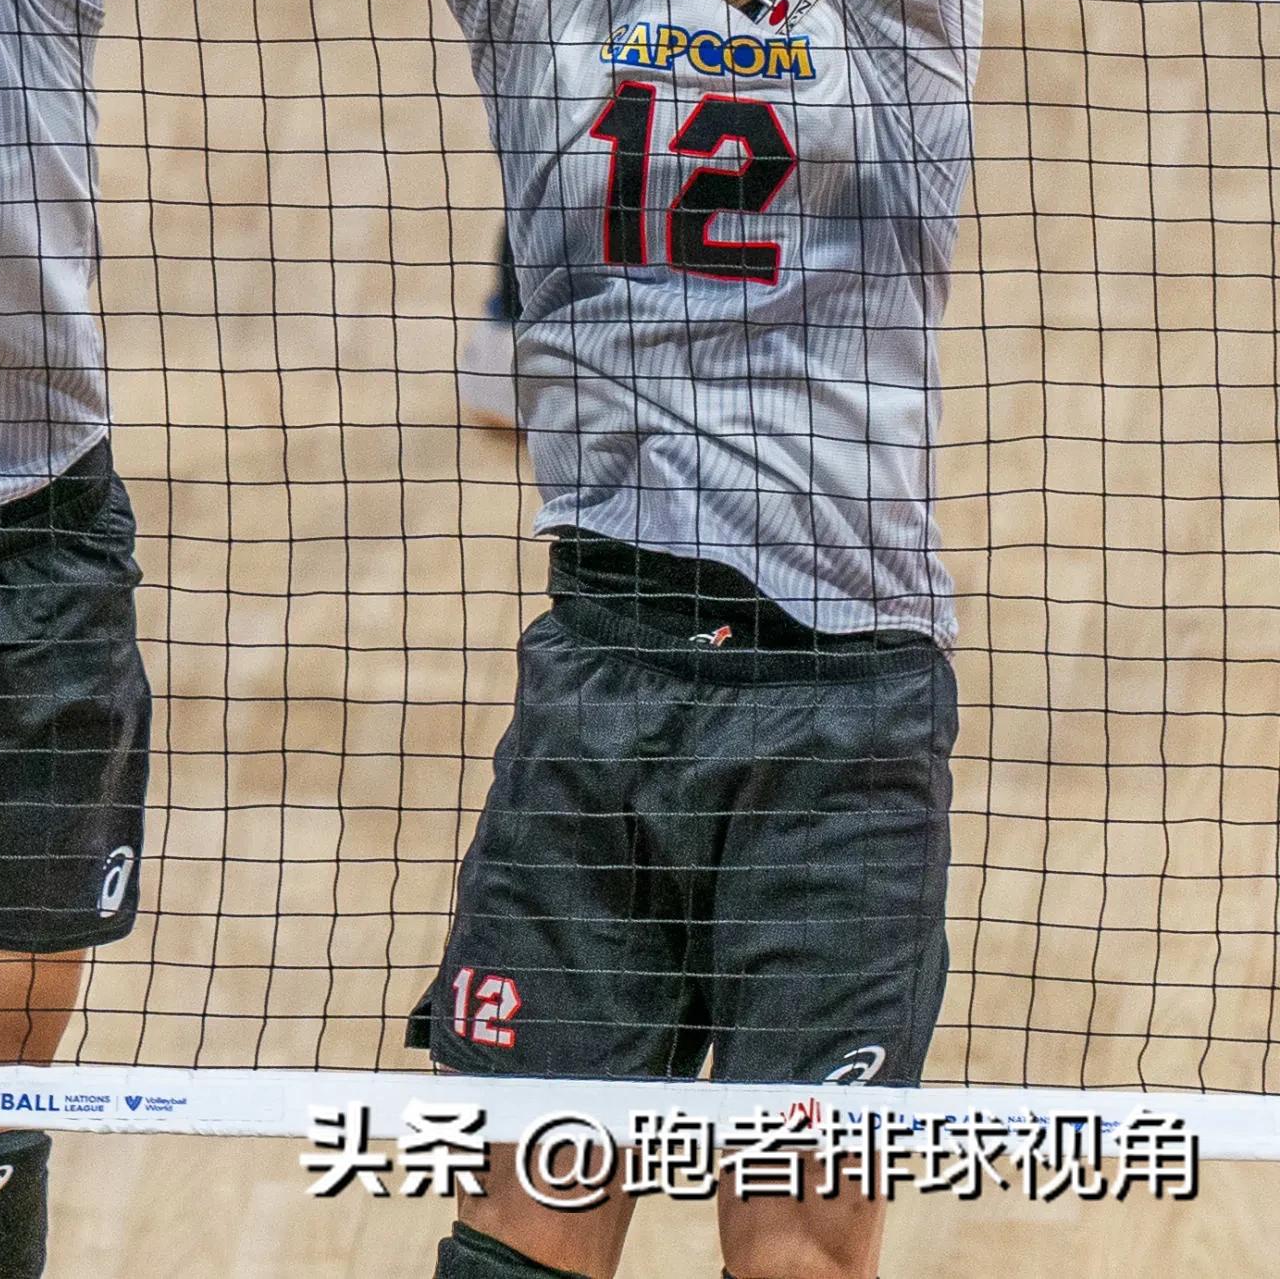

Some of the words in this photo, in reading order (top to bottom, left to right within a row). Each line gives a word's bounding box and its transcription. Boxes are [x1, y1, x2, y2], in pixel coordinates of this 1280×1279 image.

[599, 21, 816, 80] CAPCOM
[590, 80, 798, 286] 12
[452, 966, 522, 1048] 12
[64, 1095, 111, 1103] NATIONS
[64, 1104, 104, 1112] LEAGUE
